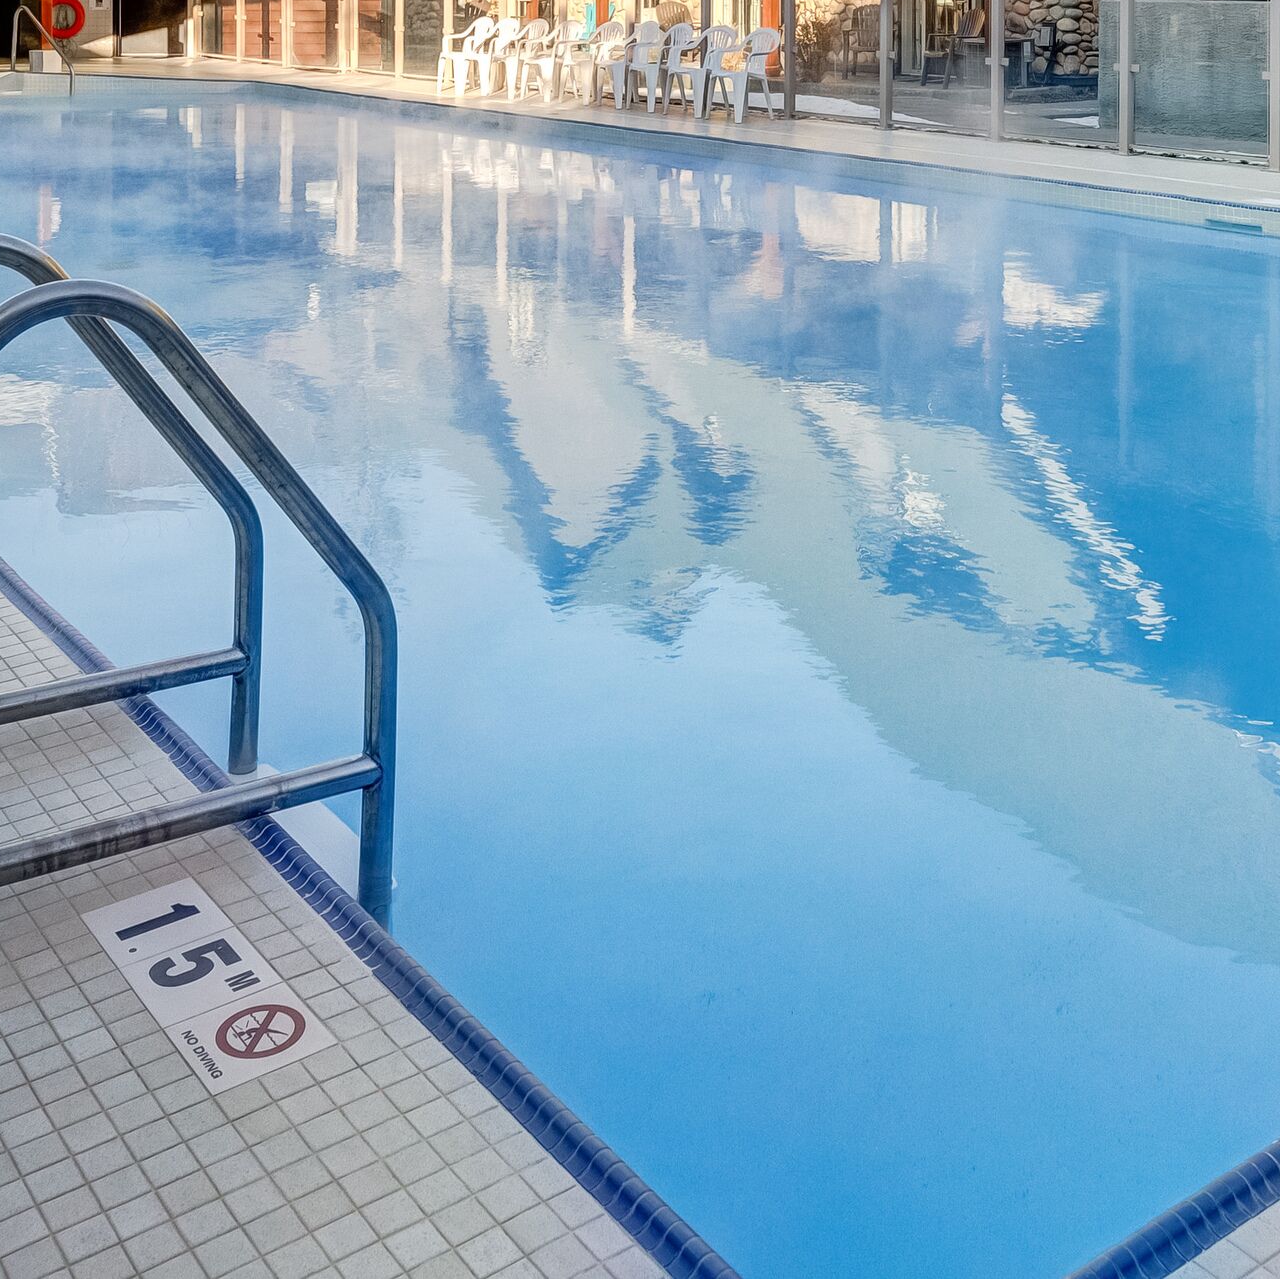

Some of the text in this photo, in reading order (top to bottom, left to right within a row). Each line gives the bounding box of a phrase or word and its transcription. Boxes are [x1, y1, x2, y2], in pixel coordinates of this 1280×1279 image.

[115, 902, 243, 988] 1.5
[181, 1030, 223, 1079] NO DIVING
